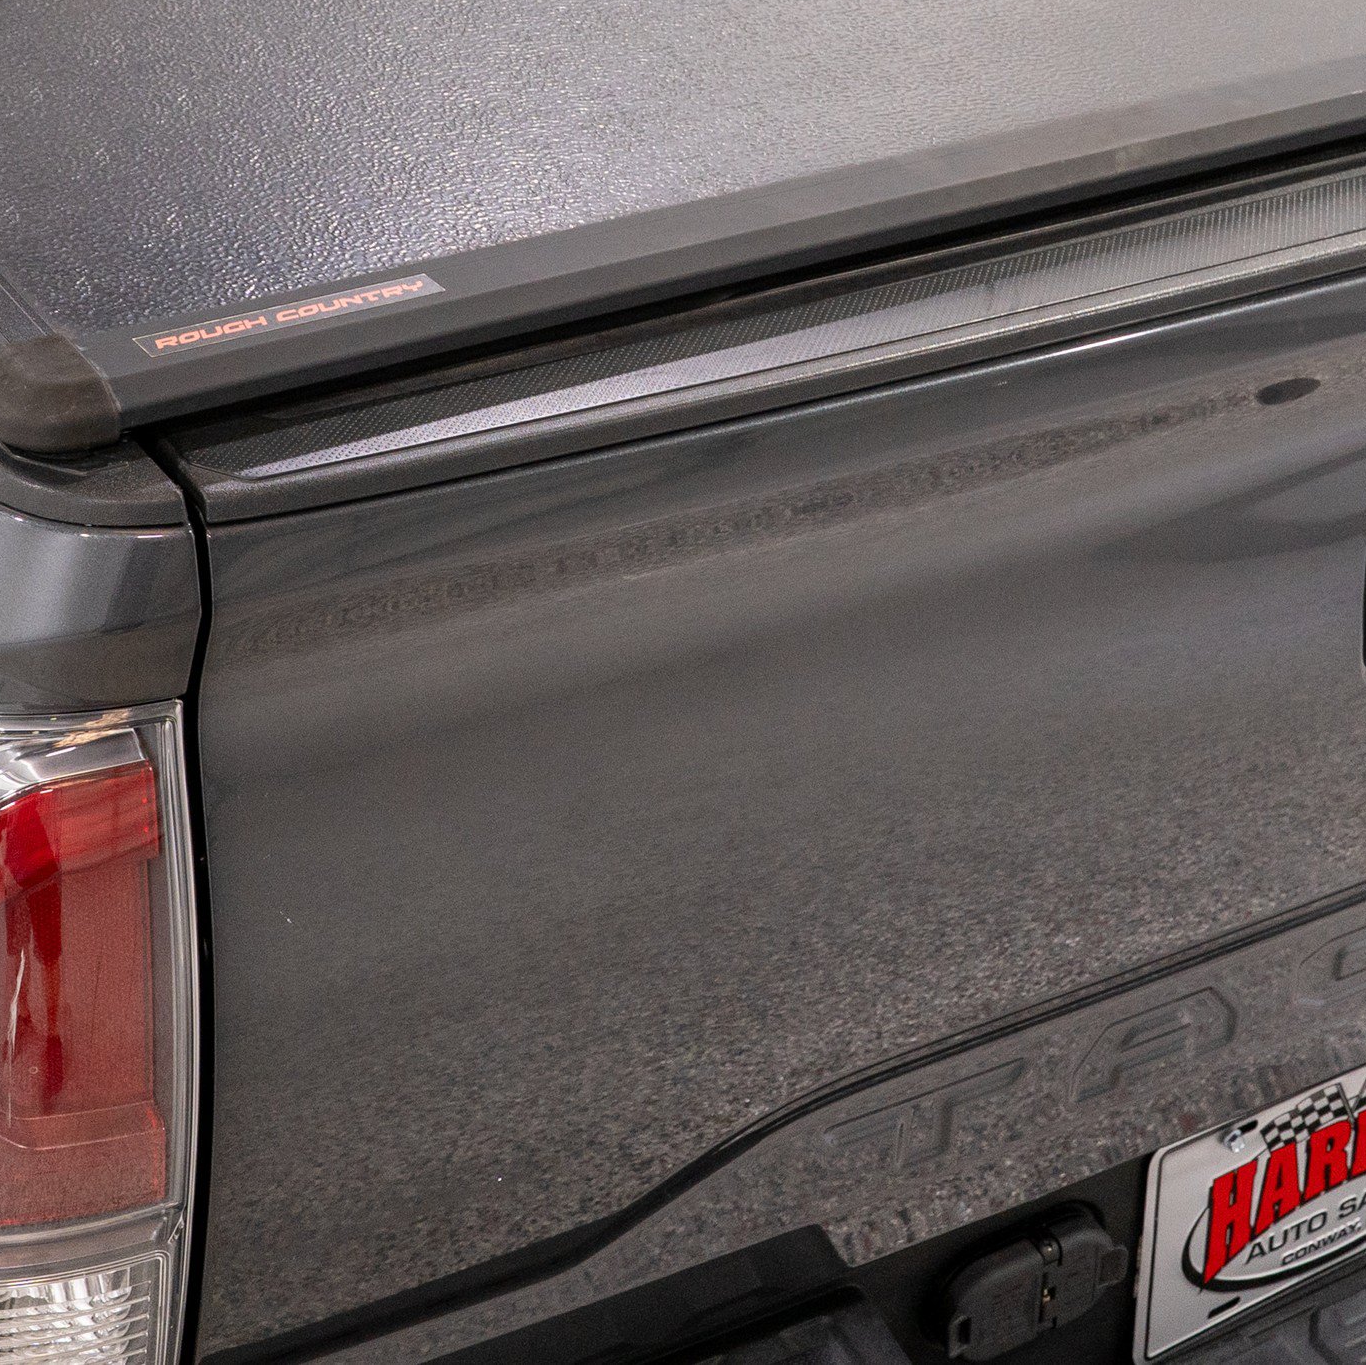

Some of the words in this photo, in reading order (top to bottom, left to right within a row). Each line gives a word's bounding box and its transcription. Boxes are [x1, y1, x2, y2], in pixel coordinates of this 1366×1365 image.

[155, 315, 267, 349] ROUGH
[276, 280, 424, 322] COUNTRY
[1245, 1210, 1328, 1264] AUTO
[1281, 1221, 1362, 1266] CONWAY,
